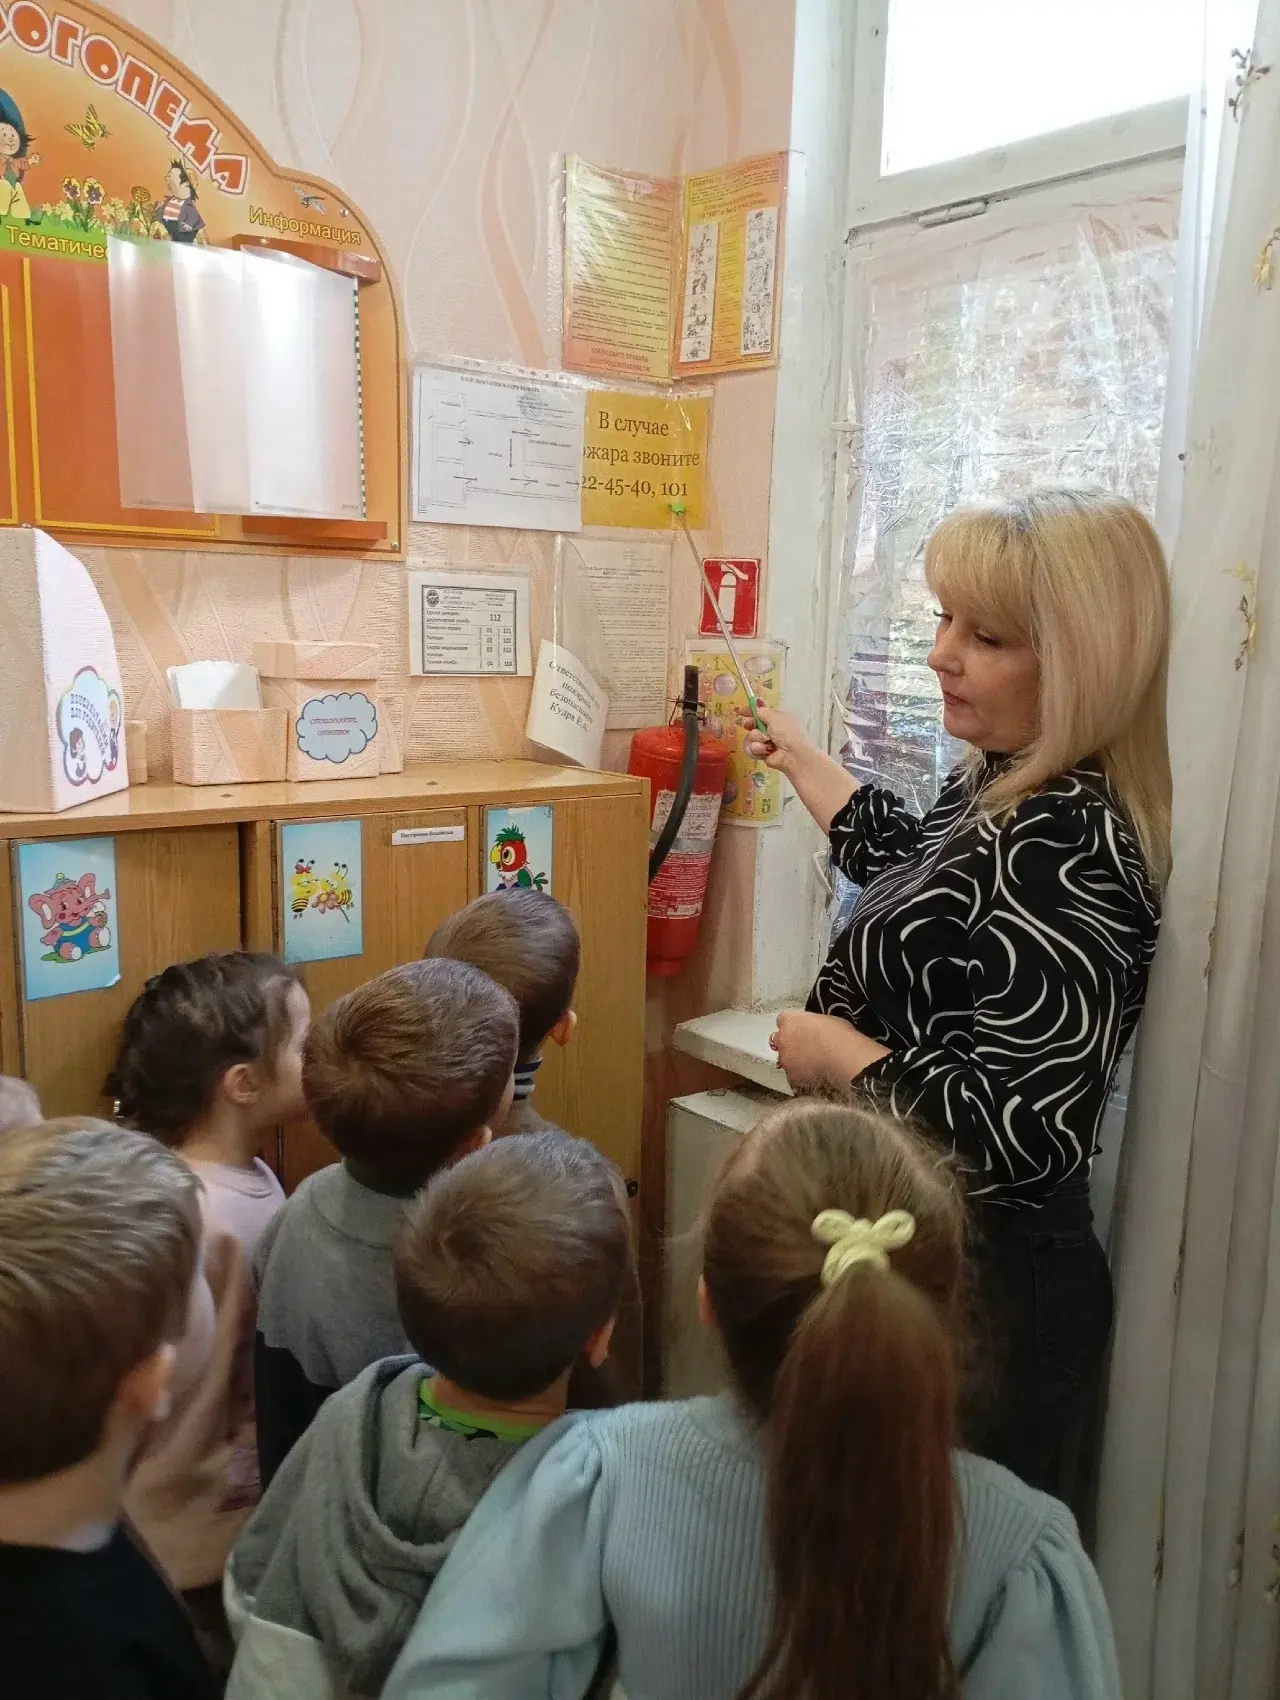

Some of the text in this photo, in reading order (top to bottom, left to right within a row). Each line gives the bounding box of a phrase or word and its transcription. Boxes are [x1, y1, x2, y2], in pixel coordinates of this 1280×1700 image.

[0, 0, 248, 195] ОГОПЕДА
[249, 204, 361, 246] Информация
[5, 225, 108, 259] Тематиче
[598, 410, 669, 438] В случае
[633, 450, 700, 467] звоните
[660, 482, 688, 497] 101
[489, 613, 502, 622] 112
